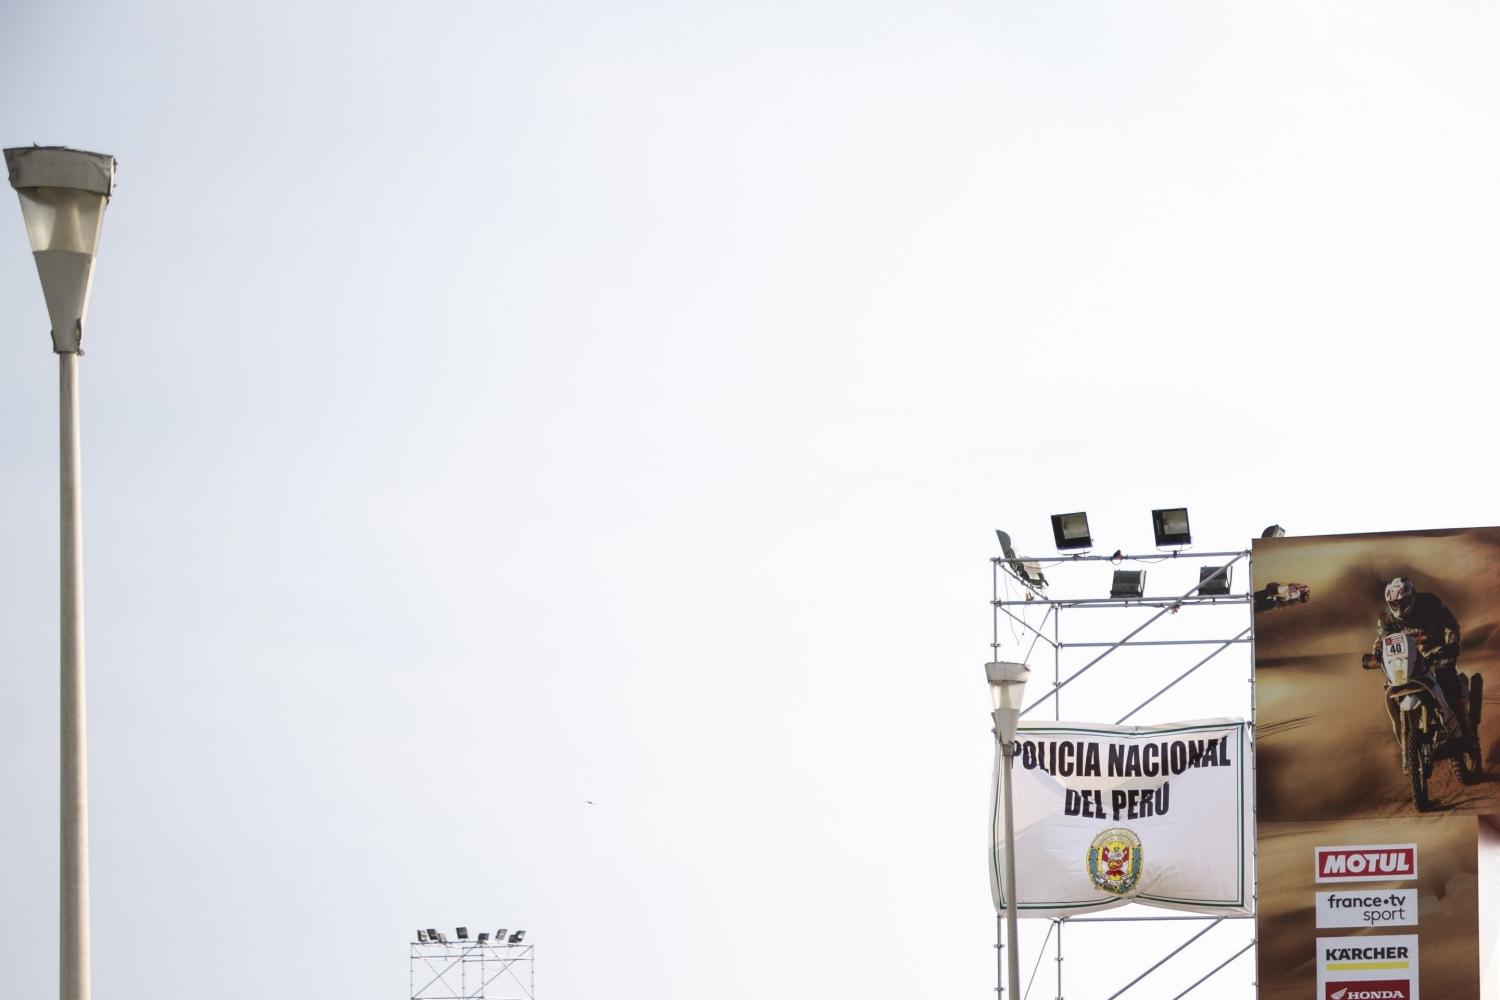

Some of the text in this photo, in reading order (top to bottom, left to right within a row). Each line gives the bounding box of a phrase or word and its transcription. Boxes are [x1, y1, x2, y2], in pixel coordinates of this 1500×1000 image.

[1010, 735, 1231, 777] POLICIA NACIONAL
[1064, 788, 1107, 820] DEL
[1323, 852, 1409, 874] MOTUL
[1363, 908, 1405, 925] sport
[1325, 946, 1409, 961] KÄRCHER
[1347, 990, 1404, 1000] HONDA
